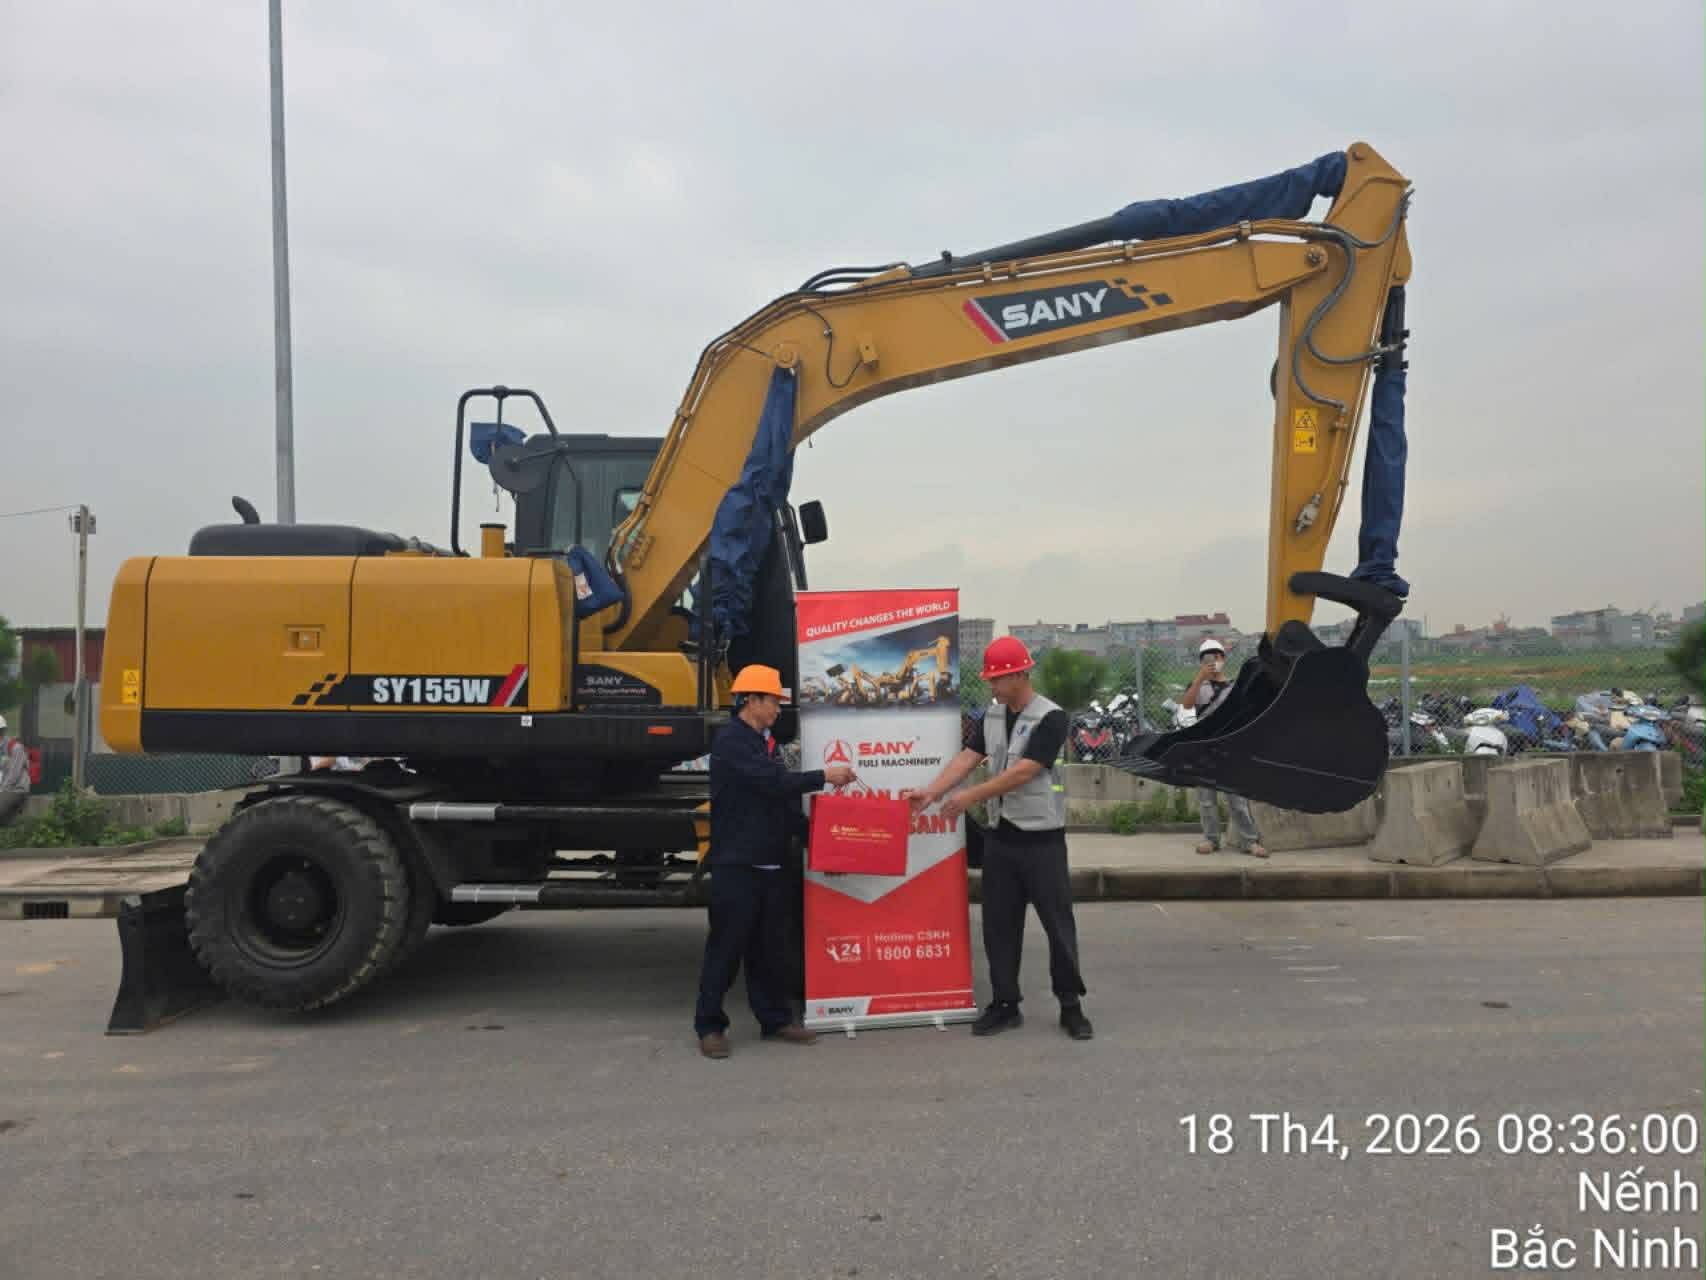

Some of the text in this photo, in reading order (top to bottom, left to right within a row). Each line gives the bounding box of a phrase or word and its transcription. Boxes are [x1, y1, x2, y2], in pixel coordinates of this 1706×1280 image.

[1002, 288, 1108, 330] SANY
[806, 600, 950, 637] QUALITY CHANGES THE WORLD
[585, 675, 624, 686] SANY
[373, 677, 490, 703] SY155W
[858, 741, 914, 756] SANY
[858, 757, 941, 767] FULI MACHINERY
[842, 943, 861, 956] 24
[877, 946, 911, 960] 1800
[916, 944, 950, 958] 6831
